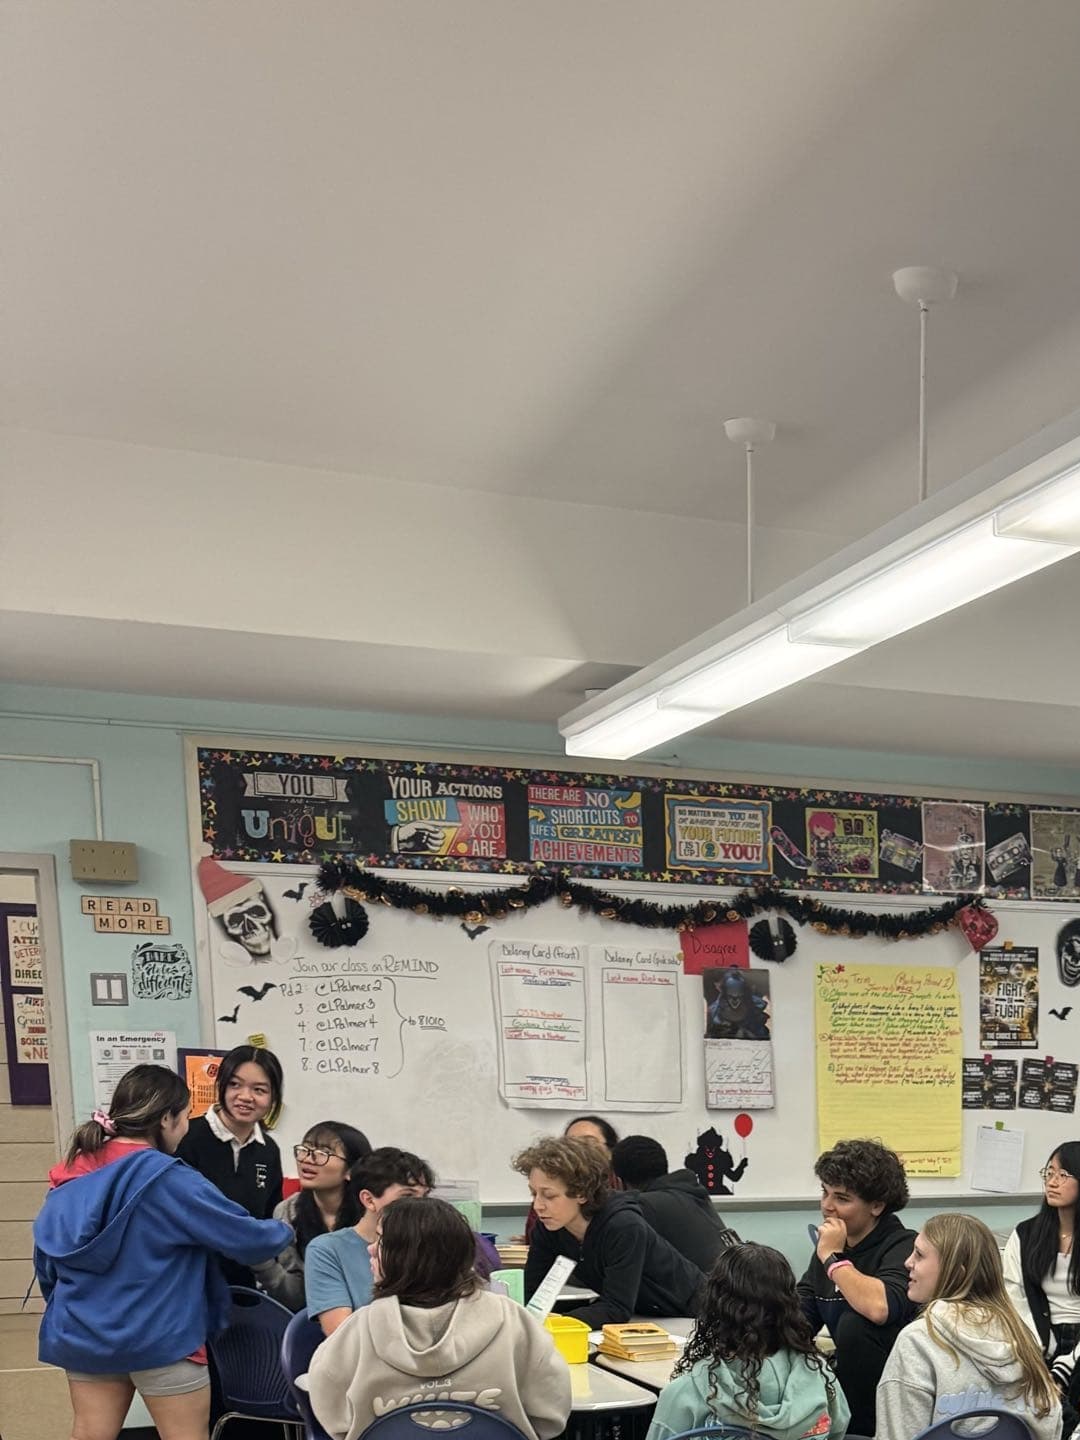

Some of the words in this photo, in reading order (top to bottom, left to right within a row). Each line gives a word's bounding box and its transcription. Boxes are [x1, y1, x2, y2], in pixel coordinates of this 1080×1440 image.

[278, 774, 314, 796] YOU
[388, 776, 432, 798] YOUR
[436, 782, 502, 799] ACTIONS
[530, 787, 560, 800] THERE
[562, 791, 581, 802] ARE
[585, 792, 609, 808] NO
[396, 800, 447, 821] SHOW
[467, 805, 498, 822] WHO
[551, 809, 620, 825] SHORTCUTS
[626, 816, 637, 824] TO
[728, 812, 746, 820] YOU
[469, 824, 501, 839] YOU
[560, 827, 640, 845] GREATEST
[680, 826, 713, 841] YOUR
[714, 828, 760, 843] FUTURE
[472, 840, 497, 857] ARE
[533, 839, 640, 863] ACHIEVEMENTS
[705, 842, 715, 857] 2
[720, 844, 762, 860] YOU!
[87, 900, 151, 912] READ
[99, 918, 163, 930] MORE
[532, 945, 550, 959] Card
[690, 934, 737, 965] Disagree
[293, 957, 318, 973] Join
[321, 964, 337, 973] our
[341, 957, 369, 973] class
[371, 964, 382, 973] on
[384, 955, 439, 973] REMIND
[636, 952, 651, 965] Card
[997, 983, 1024, 997] FIGHT
